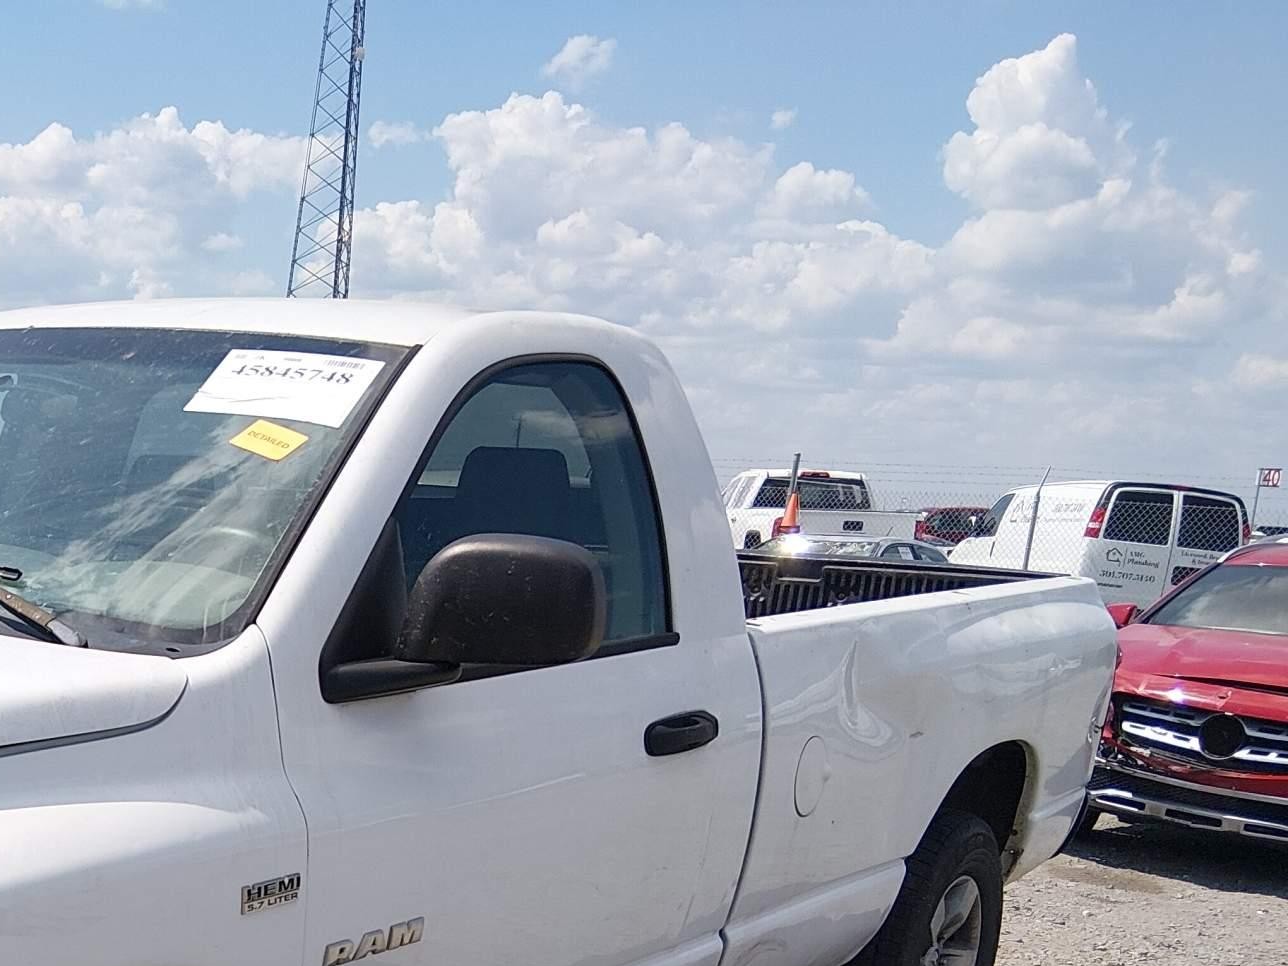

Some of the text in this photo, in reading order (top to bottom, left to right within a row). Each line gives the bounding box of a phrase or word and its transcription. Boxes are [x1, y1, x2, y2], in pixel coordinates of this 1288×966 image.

[231, 363, 354, 385] 45845748
[247, 430, 290, 449] DETAILED
[1263, 469, 1281, 487] 40
[245, 873, 301, 901] HEMI
[247, 891, 298, 912] 5.7 LITER
